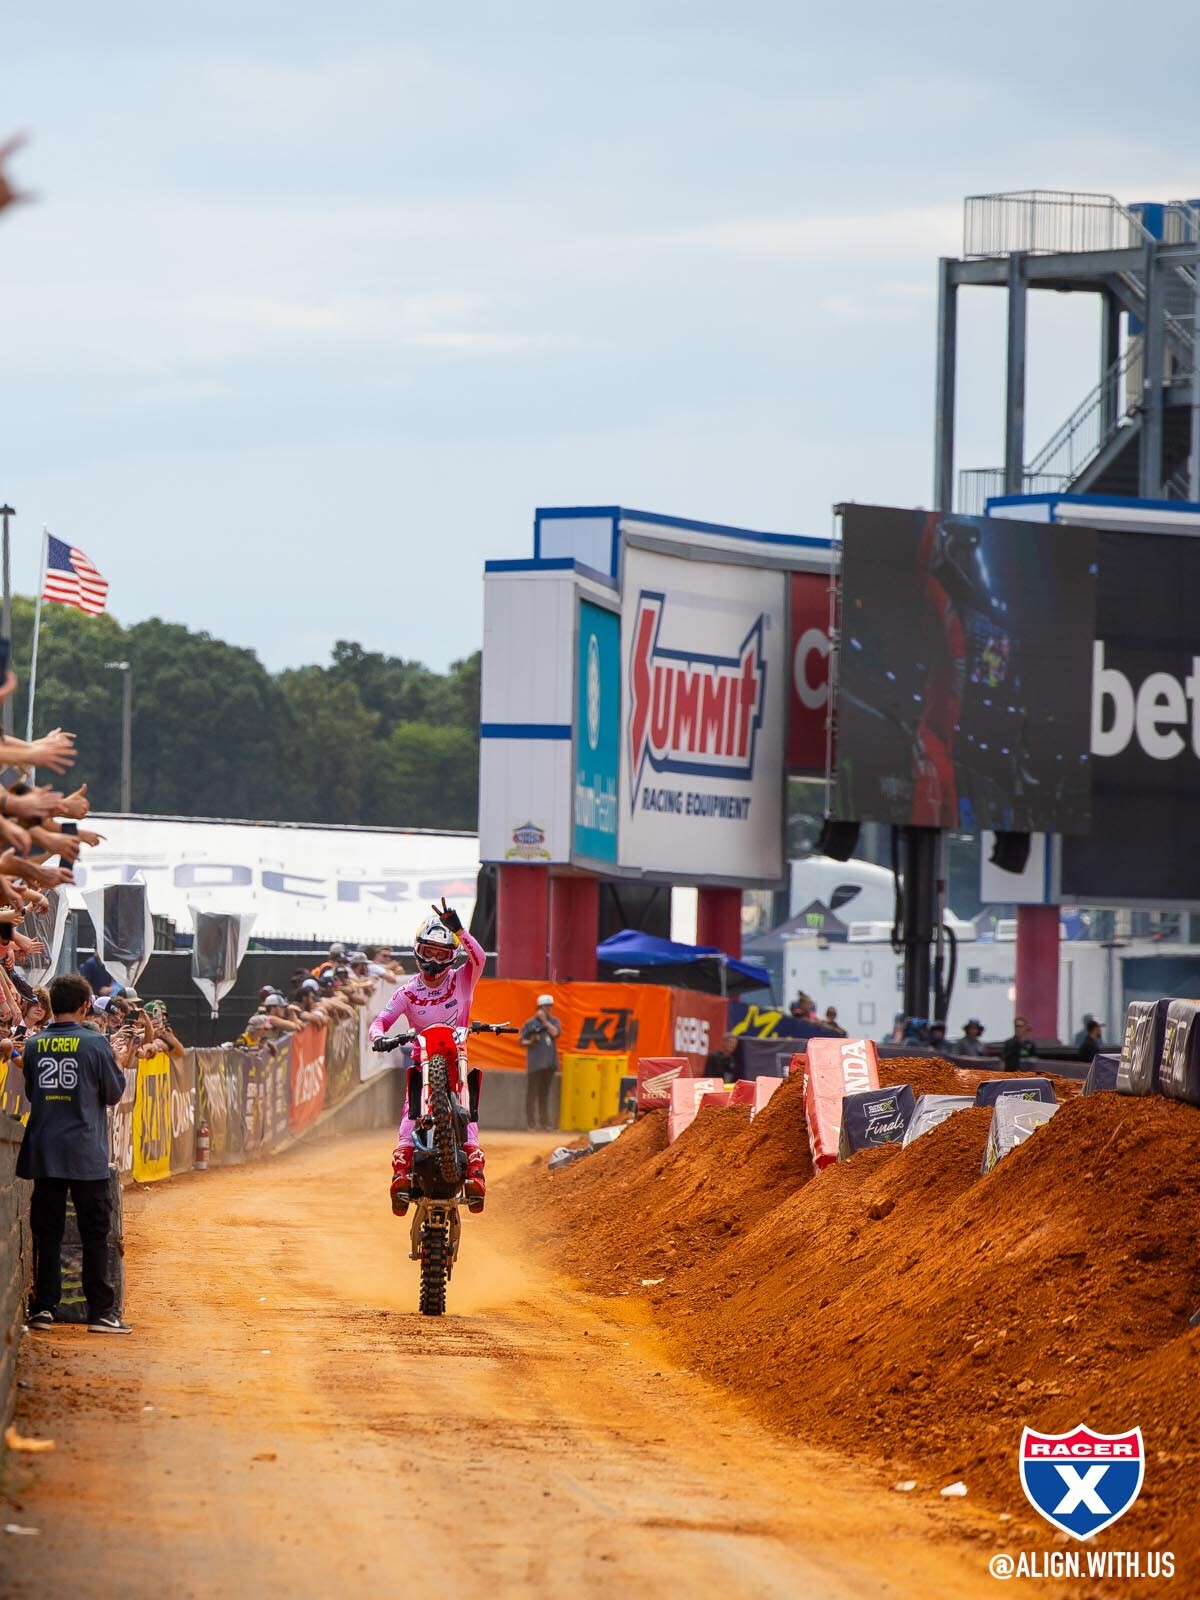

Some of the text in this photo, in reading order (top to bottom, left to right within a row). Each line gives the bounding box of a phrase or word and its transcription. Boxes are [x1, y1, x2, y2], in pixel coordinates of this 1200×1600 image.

[641, 786, 683, 814] RACING
[685, 792, 752, 820] EQUIPMENT
[36, 1037, 80, 1053] TV CREW
[37, 1057, 79, 1089] 26
[865, 1112, 904, 1139] Finals
